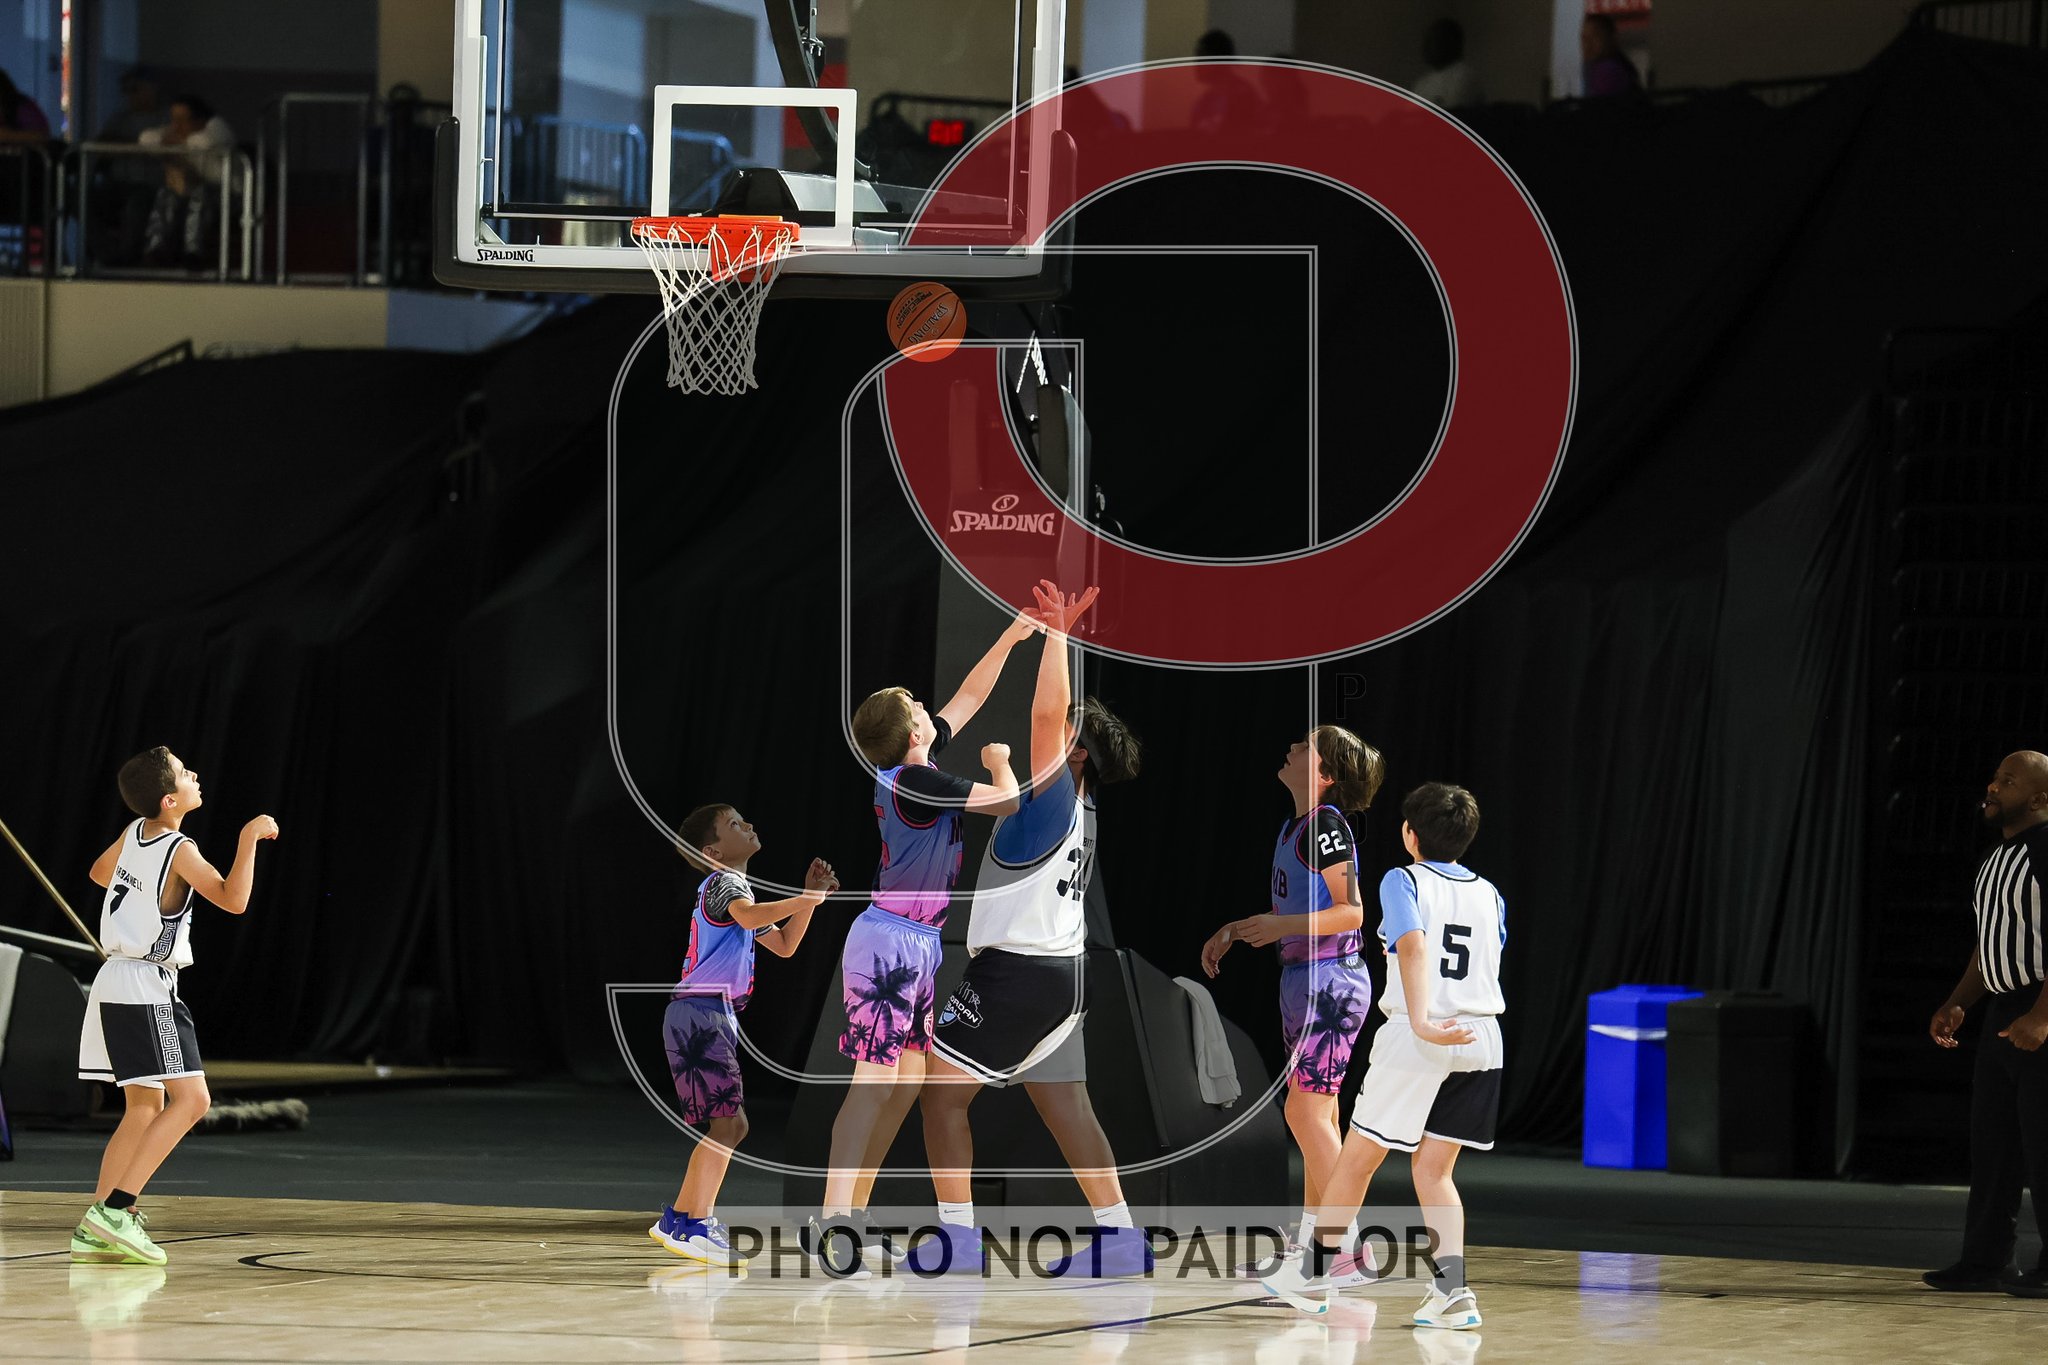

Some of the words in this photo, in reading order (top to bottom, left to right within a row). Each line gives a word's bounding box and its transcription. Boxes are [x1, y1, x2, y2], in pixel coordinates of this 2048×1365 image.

[477, 249, 535, 262] SPALDING
[908, 303, 949, 344] SPALDING
[949, 510, 1055, 536] SPALDING
[1318, 829, 1346, 855] 22
[109, 883, 131, 918] 7
[1439, 923, 1472, 981] 5
[949, 994, 979, 1024] ORDAN
